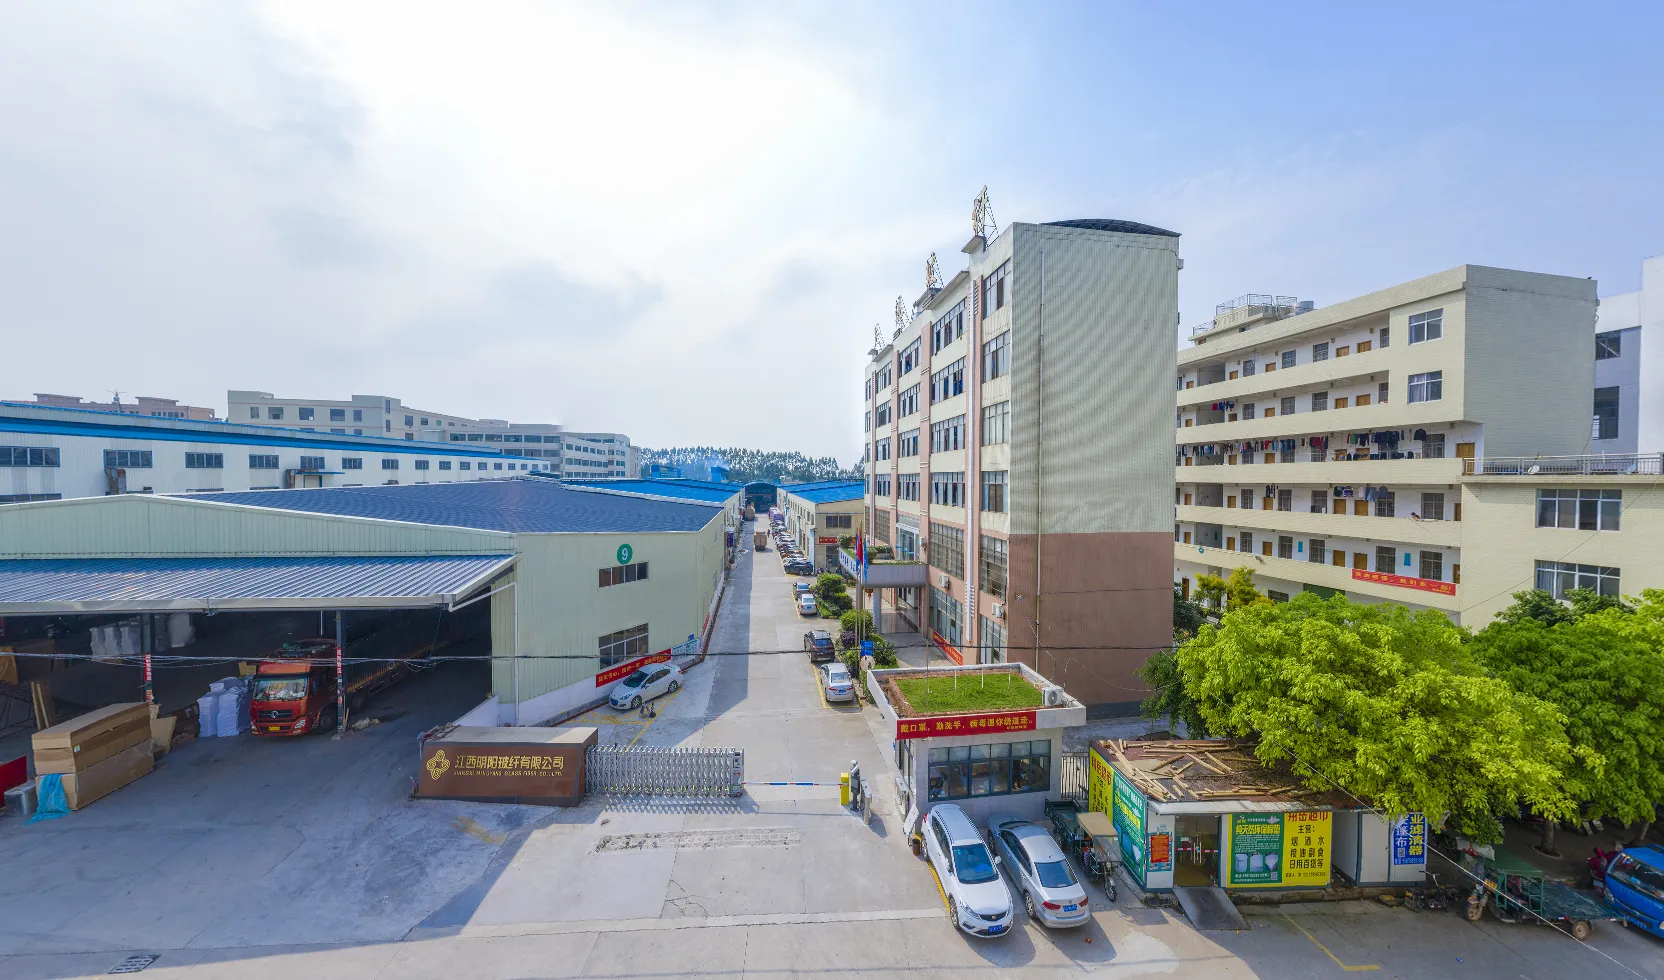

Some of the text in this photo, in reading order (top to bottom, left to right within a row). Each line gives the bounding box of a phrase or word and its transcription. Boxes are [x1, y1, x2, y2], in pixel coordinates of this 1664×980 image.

[621, 547, 629, 561] 9
[454, 755, 564, 770] 江西明阳玻纤有限公司
[1289, 858, 1324, 869] 日用百货等
